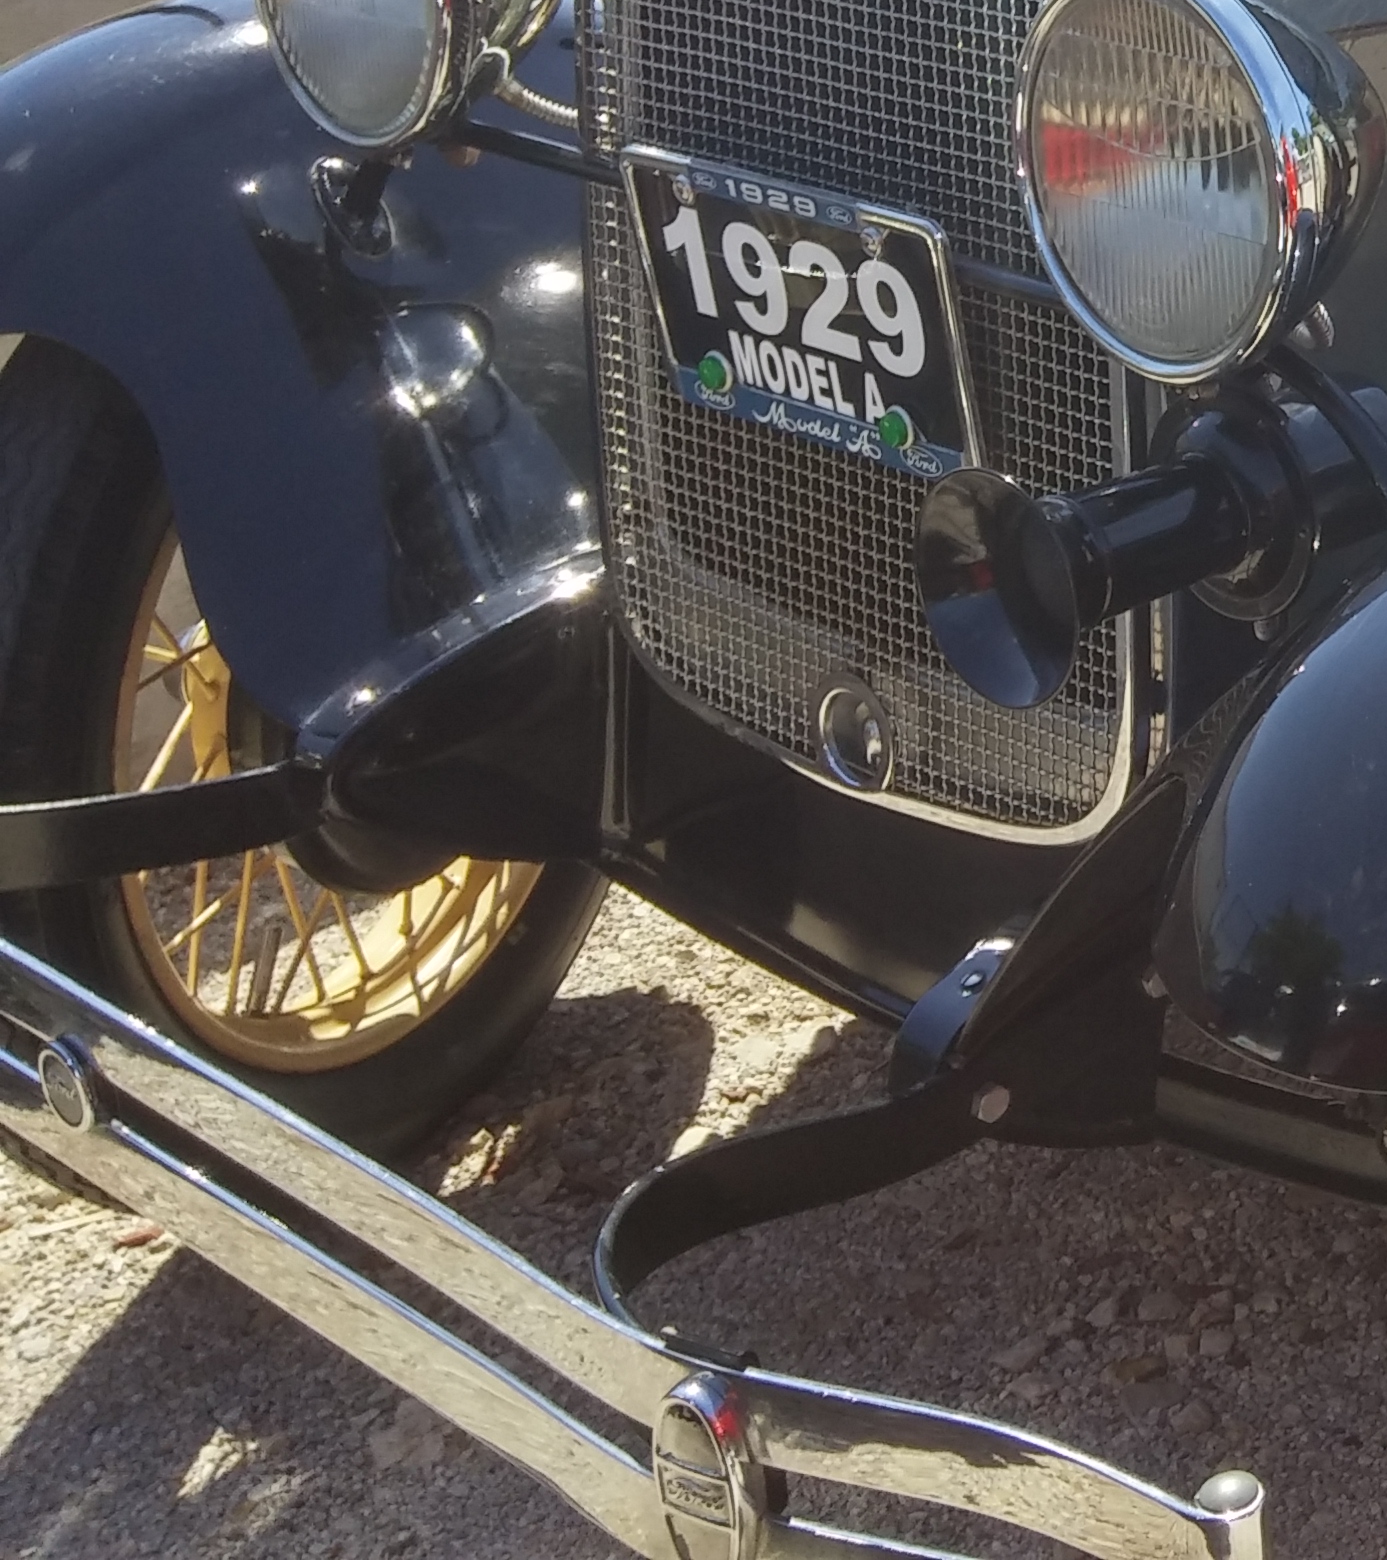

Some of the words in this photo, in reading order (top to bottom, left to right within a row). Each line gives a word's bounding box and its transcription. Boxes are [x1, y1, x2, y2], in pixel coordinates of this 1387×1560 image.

[724, 178, 816, 218] 1929
[662, 206, 926, 378] 1929
[728, 329, 856, 418] MODEL
[864, 371, 886, 425] A
[752, 401, 842, 443] Model
[906, 448, 938, 473] Ford
[666, 1476, 726, 1511] Ford
